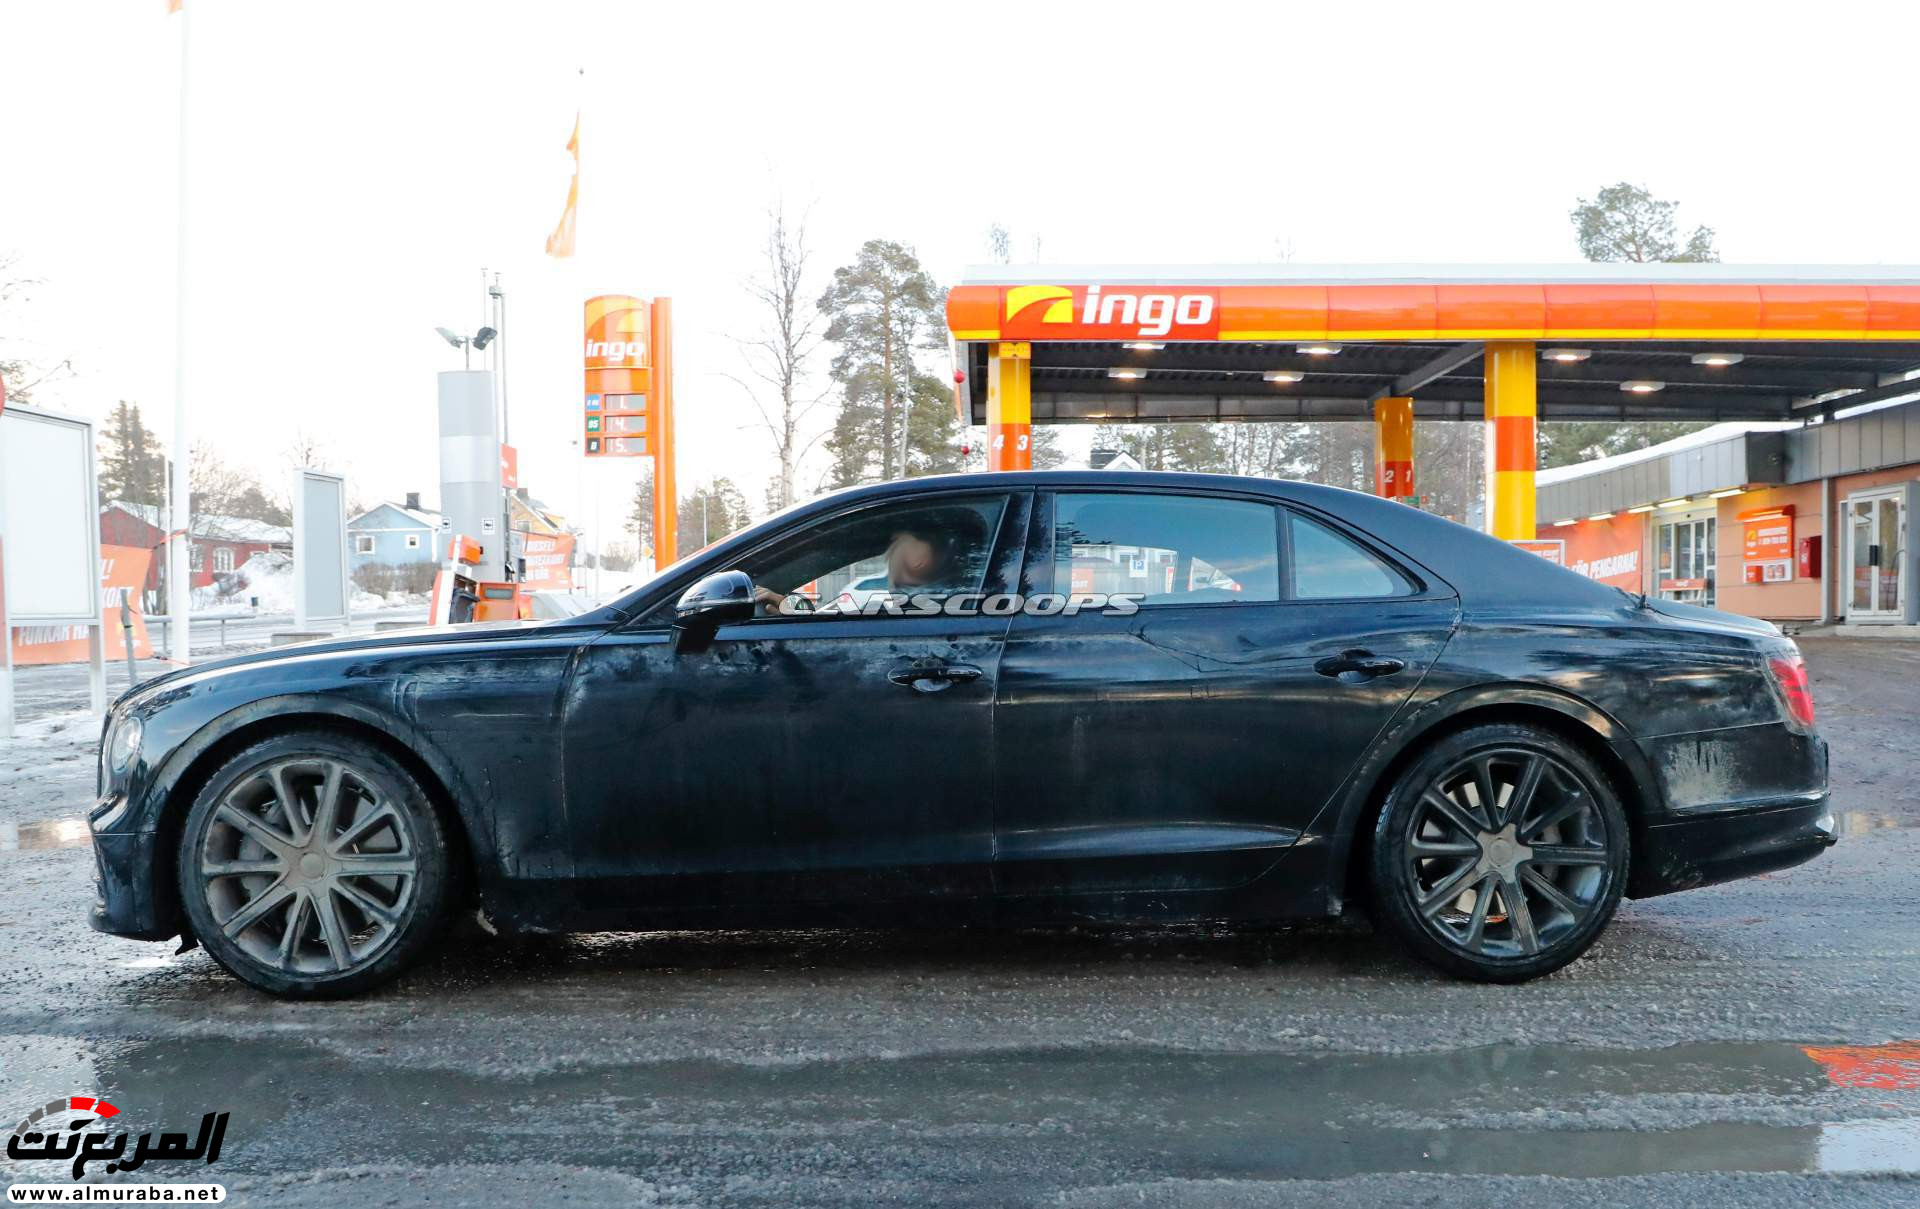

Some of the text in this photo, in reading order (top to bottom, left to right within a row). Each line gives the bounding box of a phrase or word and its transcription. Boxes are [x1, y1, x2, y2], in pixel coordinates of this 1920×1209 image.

[1082, 285, 1214, 336] ingo
[586, 339, 644, 361] ingo
[992, 434, 1028, 451] 4 3
[1384, 470, 1412, 483] 2 1
